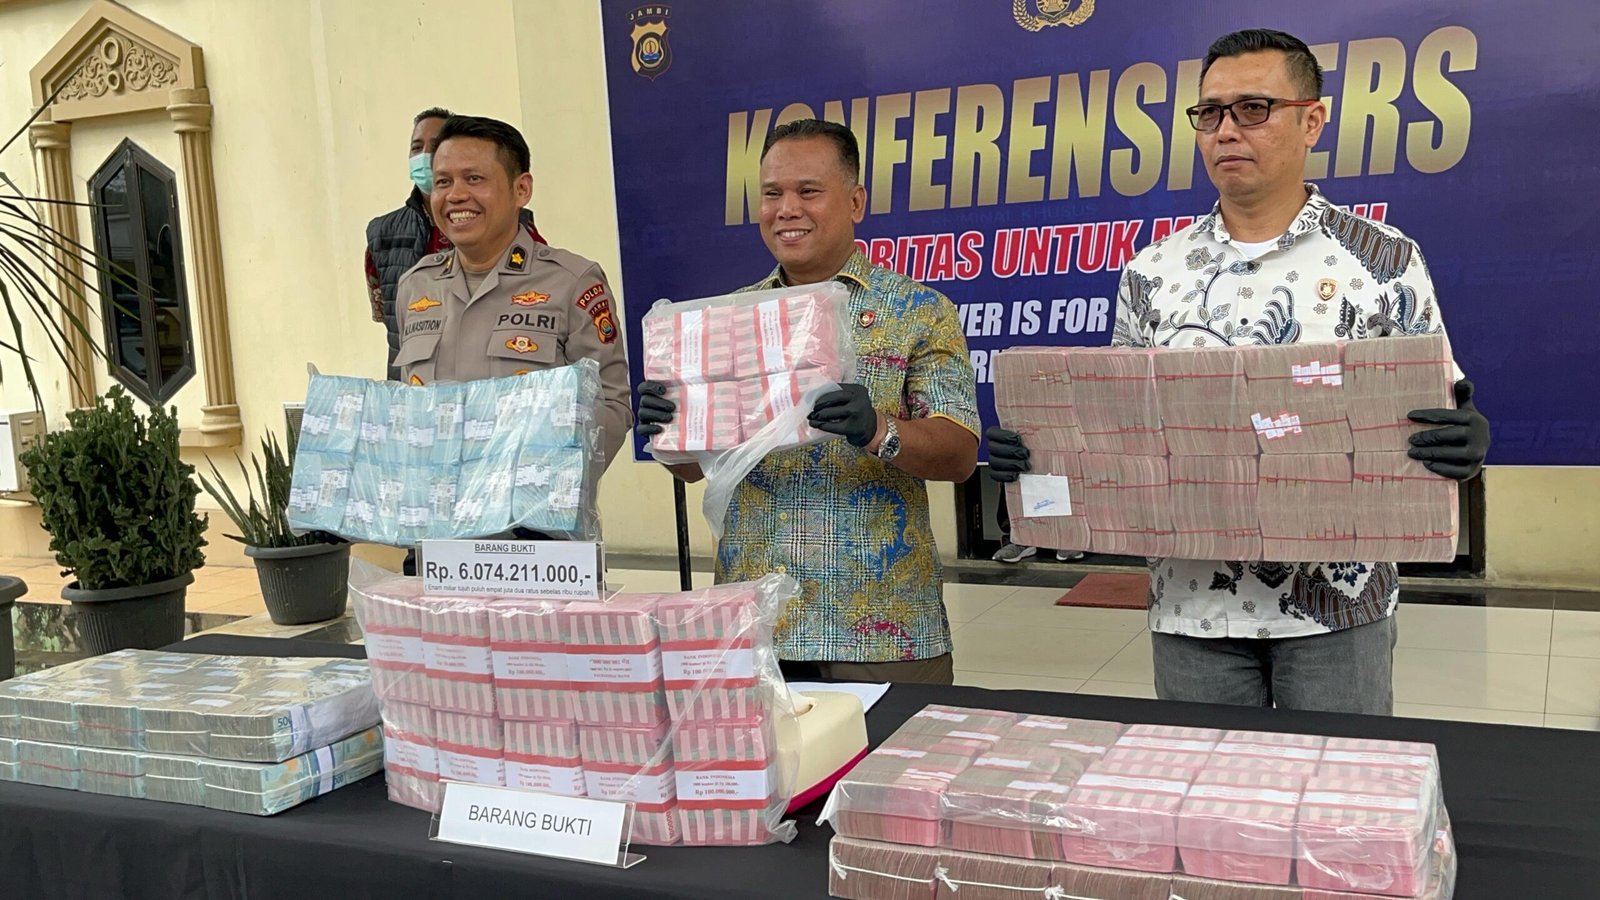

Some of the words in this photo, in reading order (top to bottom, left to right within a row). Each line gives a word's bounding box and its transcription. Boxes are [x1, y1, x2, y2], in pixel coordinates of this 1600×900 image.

[628, 7, 670, 21] JAMBI
[992, 219, 1147, 278] UNTUK
[579, 285, 604, 308] POLDA
[497, 313, 556, 330] POLRI
[1009, 300, 1042, 336] IS
[1048, 297, 1110, 334] FOR
[474, 543, 509, 553] BARANG
[511, 544, 536, 554] BUKTI
[426, 561, 453, 583] Rp.
[458, 562, 591, 587] 6.074.211.000,-
[468, 804, 537, 829] BARANG
[541, 814, 593, 836] BUKTI
